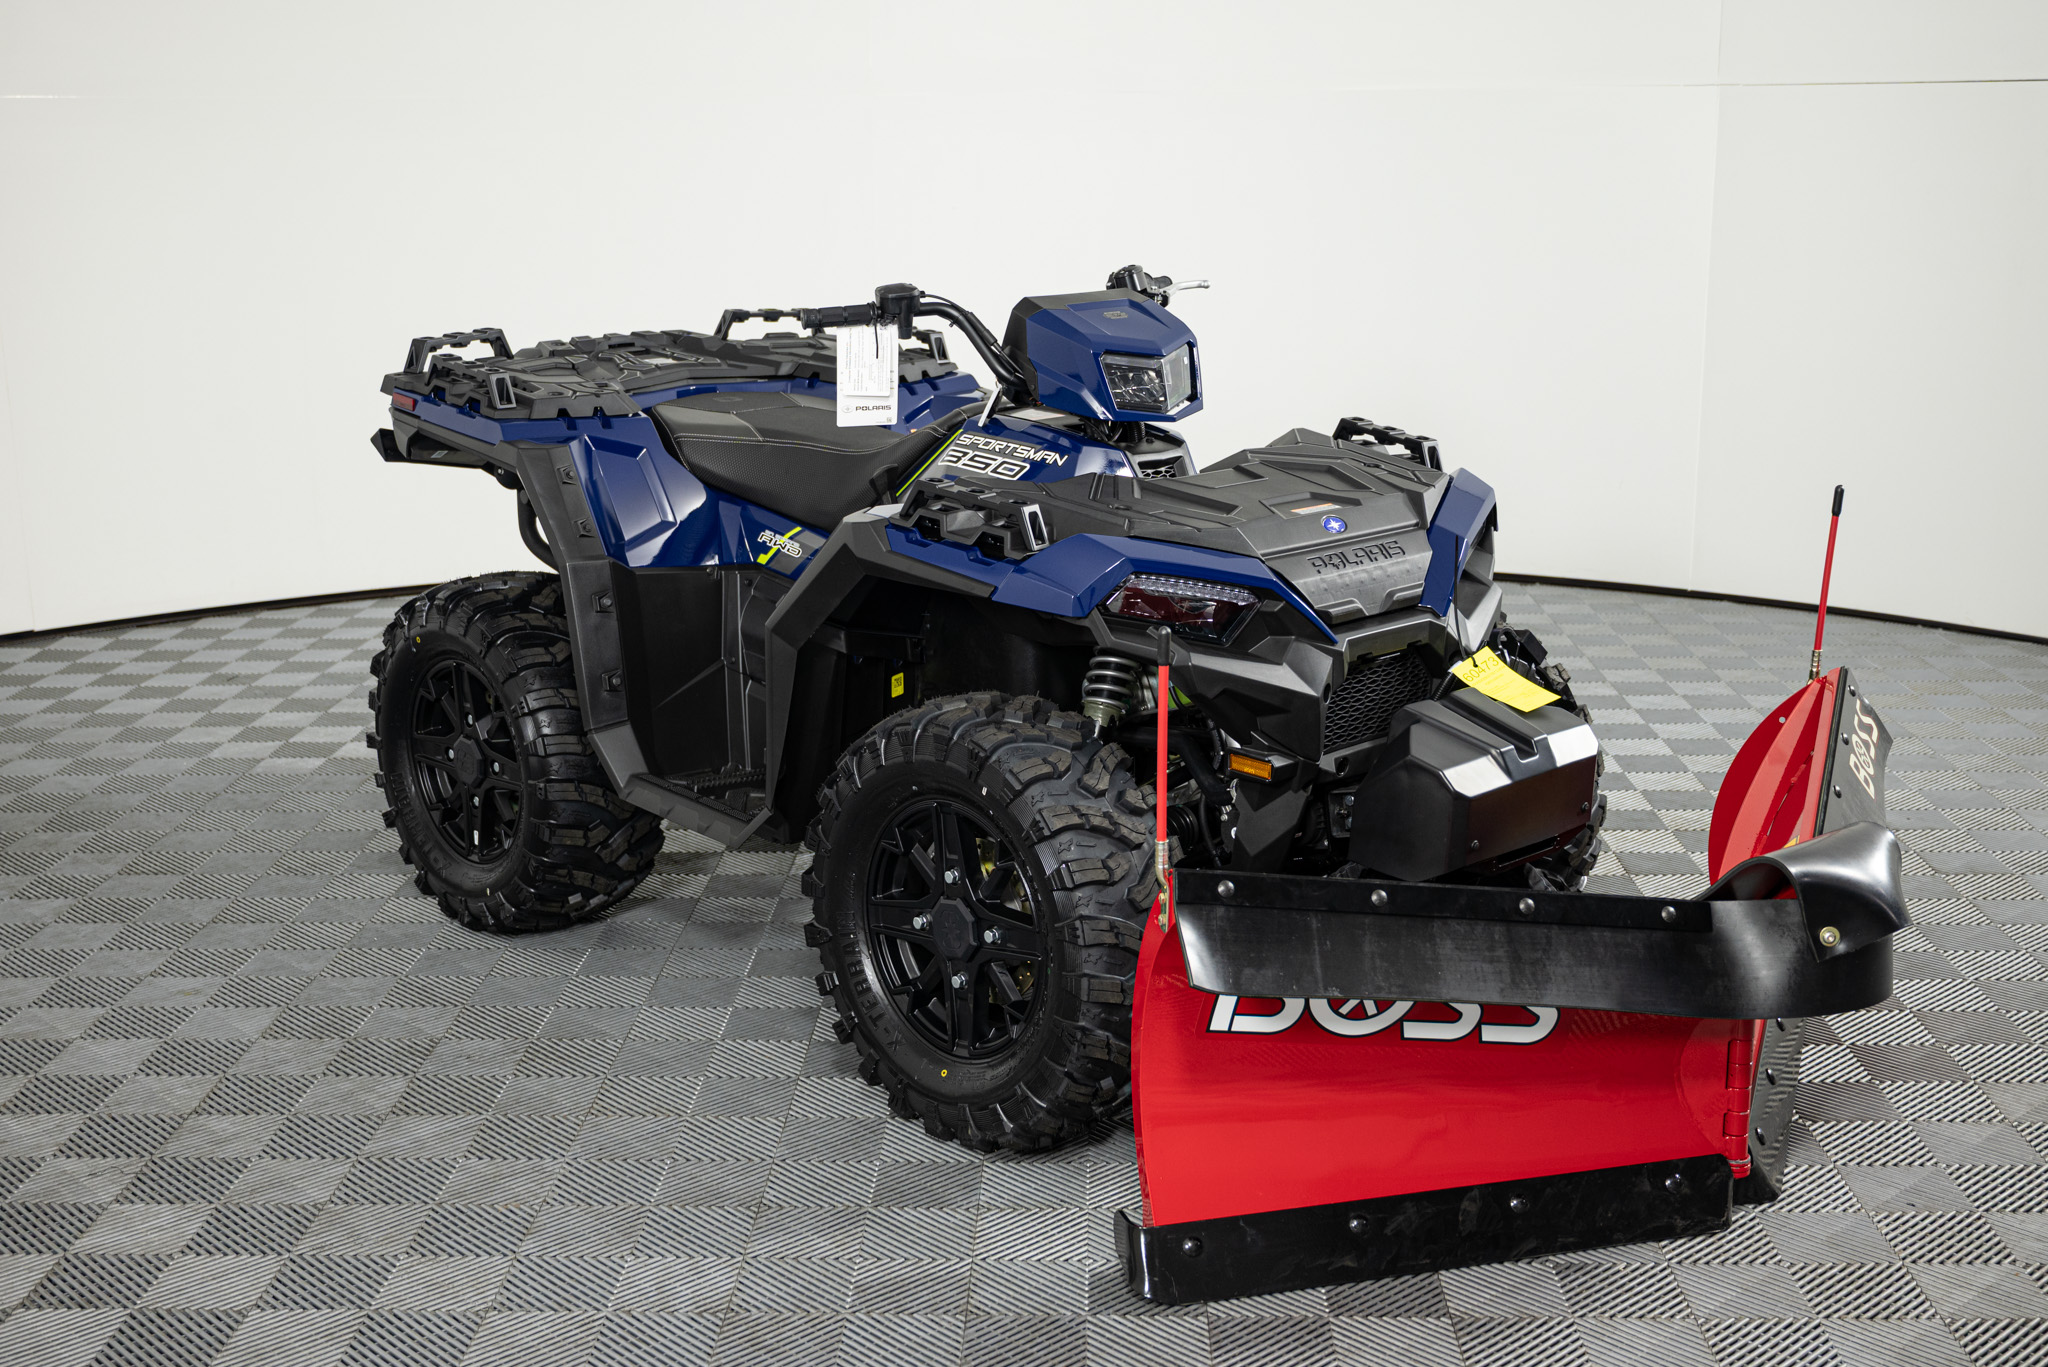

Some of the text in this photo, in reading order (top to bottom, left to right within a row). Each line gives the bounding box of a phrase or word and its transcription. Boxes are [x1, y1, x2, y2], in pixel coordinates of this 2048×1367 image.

[855, 404, 892, 412] POLARIS
[956, 433, 1069, 467] SPORTSMAN
[757, 532, 803, 558] AWD
[1306, 540, 1406, 575] POLARIS
[1462, 655, 1500, 683] 60473
[1849, 698, 1879, 800] BOSS
